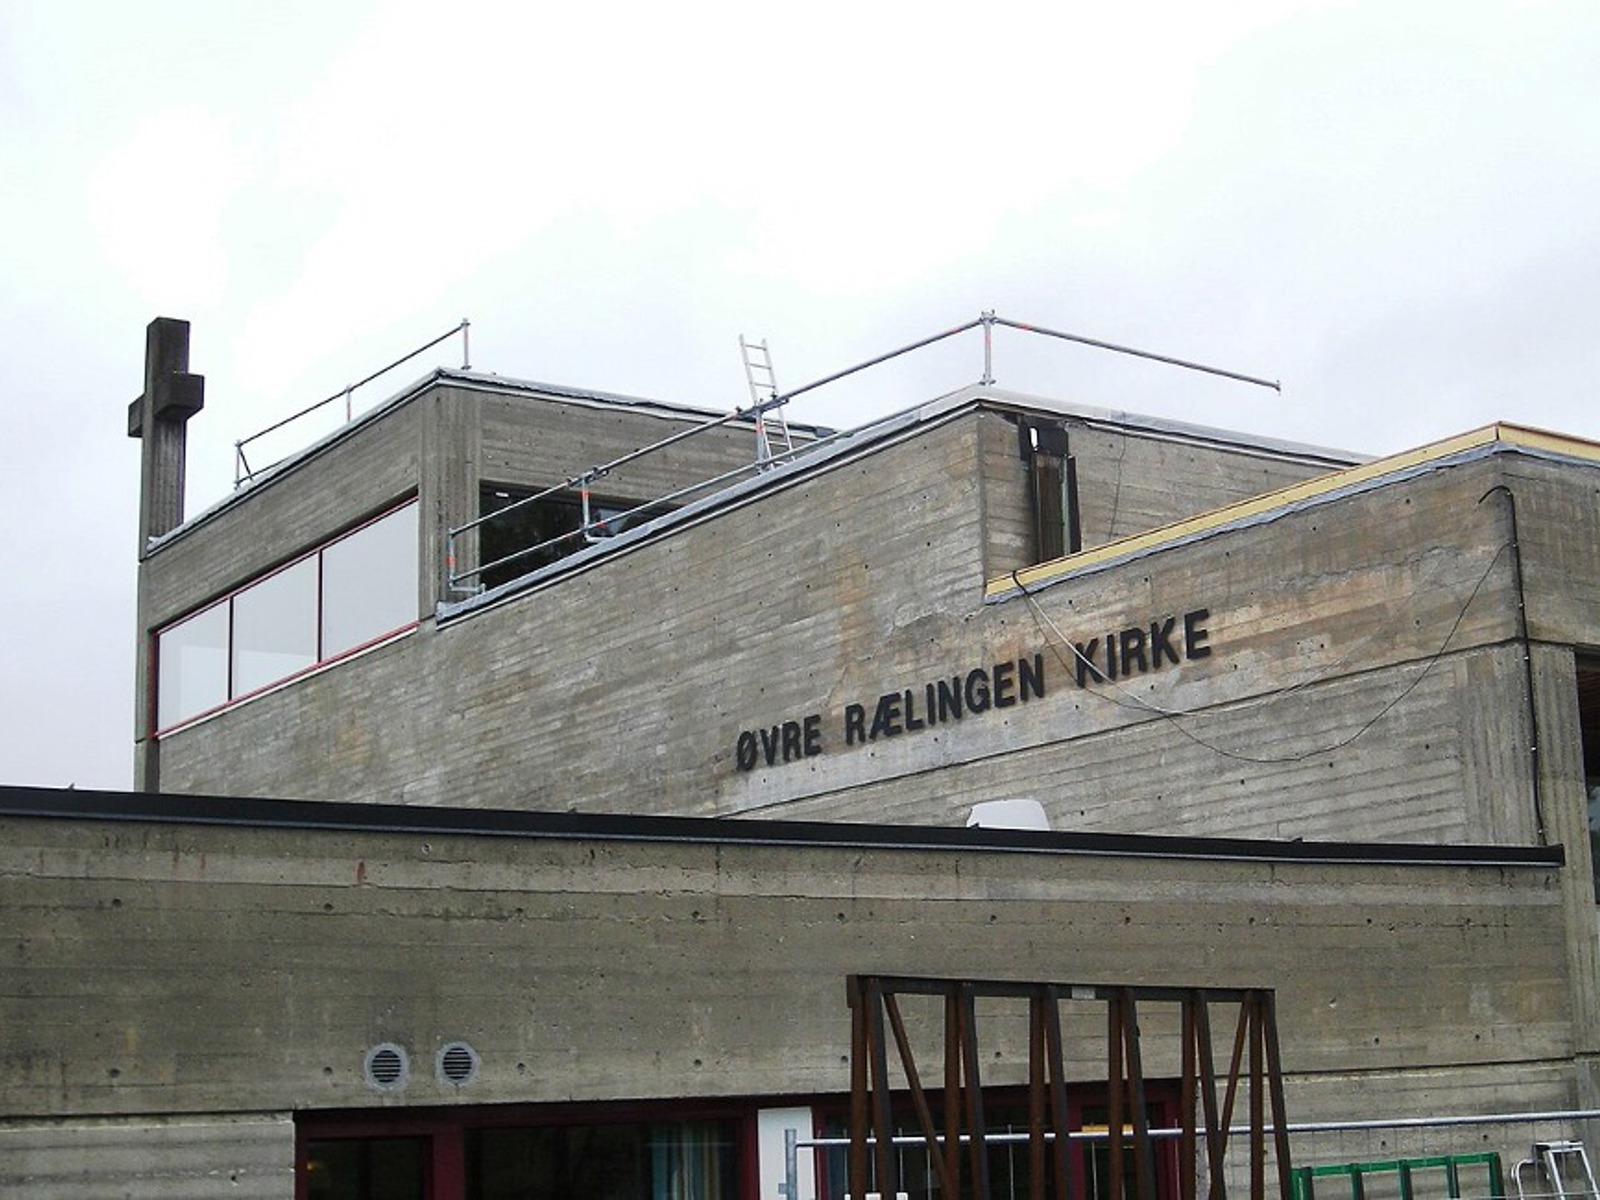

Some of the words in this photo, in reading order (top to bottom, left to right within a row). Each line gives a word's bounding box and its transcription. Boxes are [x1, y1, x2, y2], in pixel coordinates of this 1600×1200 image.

[736, 714, 822, 772] ØVRE
[845, 653, 1045, 746] RÆLINGEN
[1075, 608, 1211, 688] KIRKE
